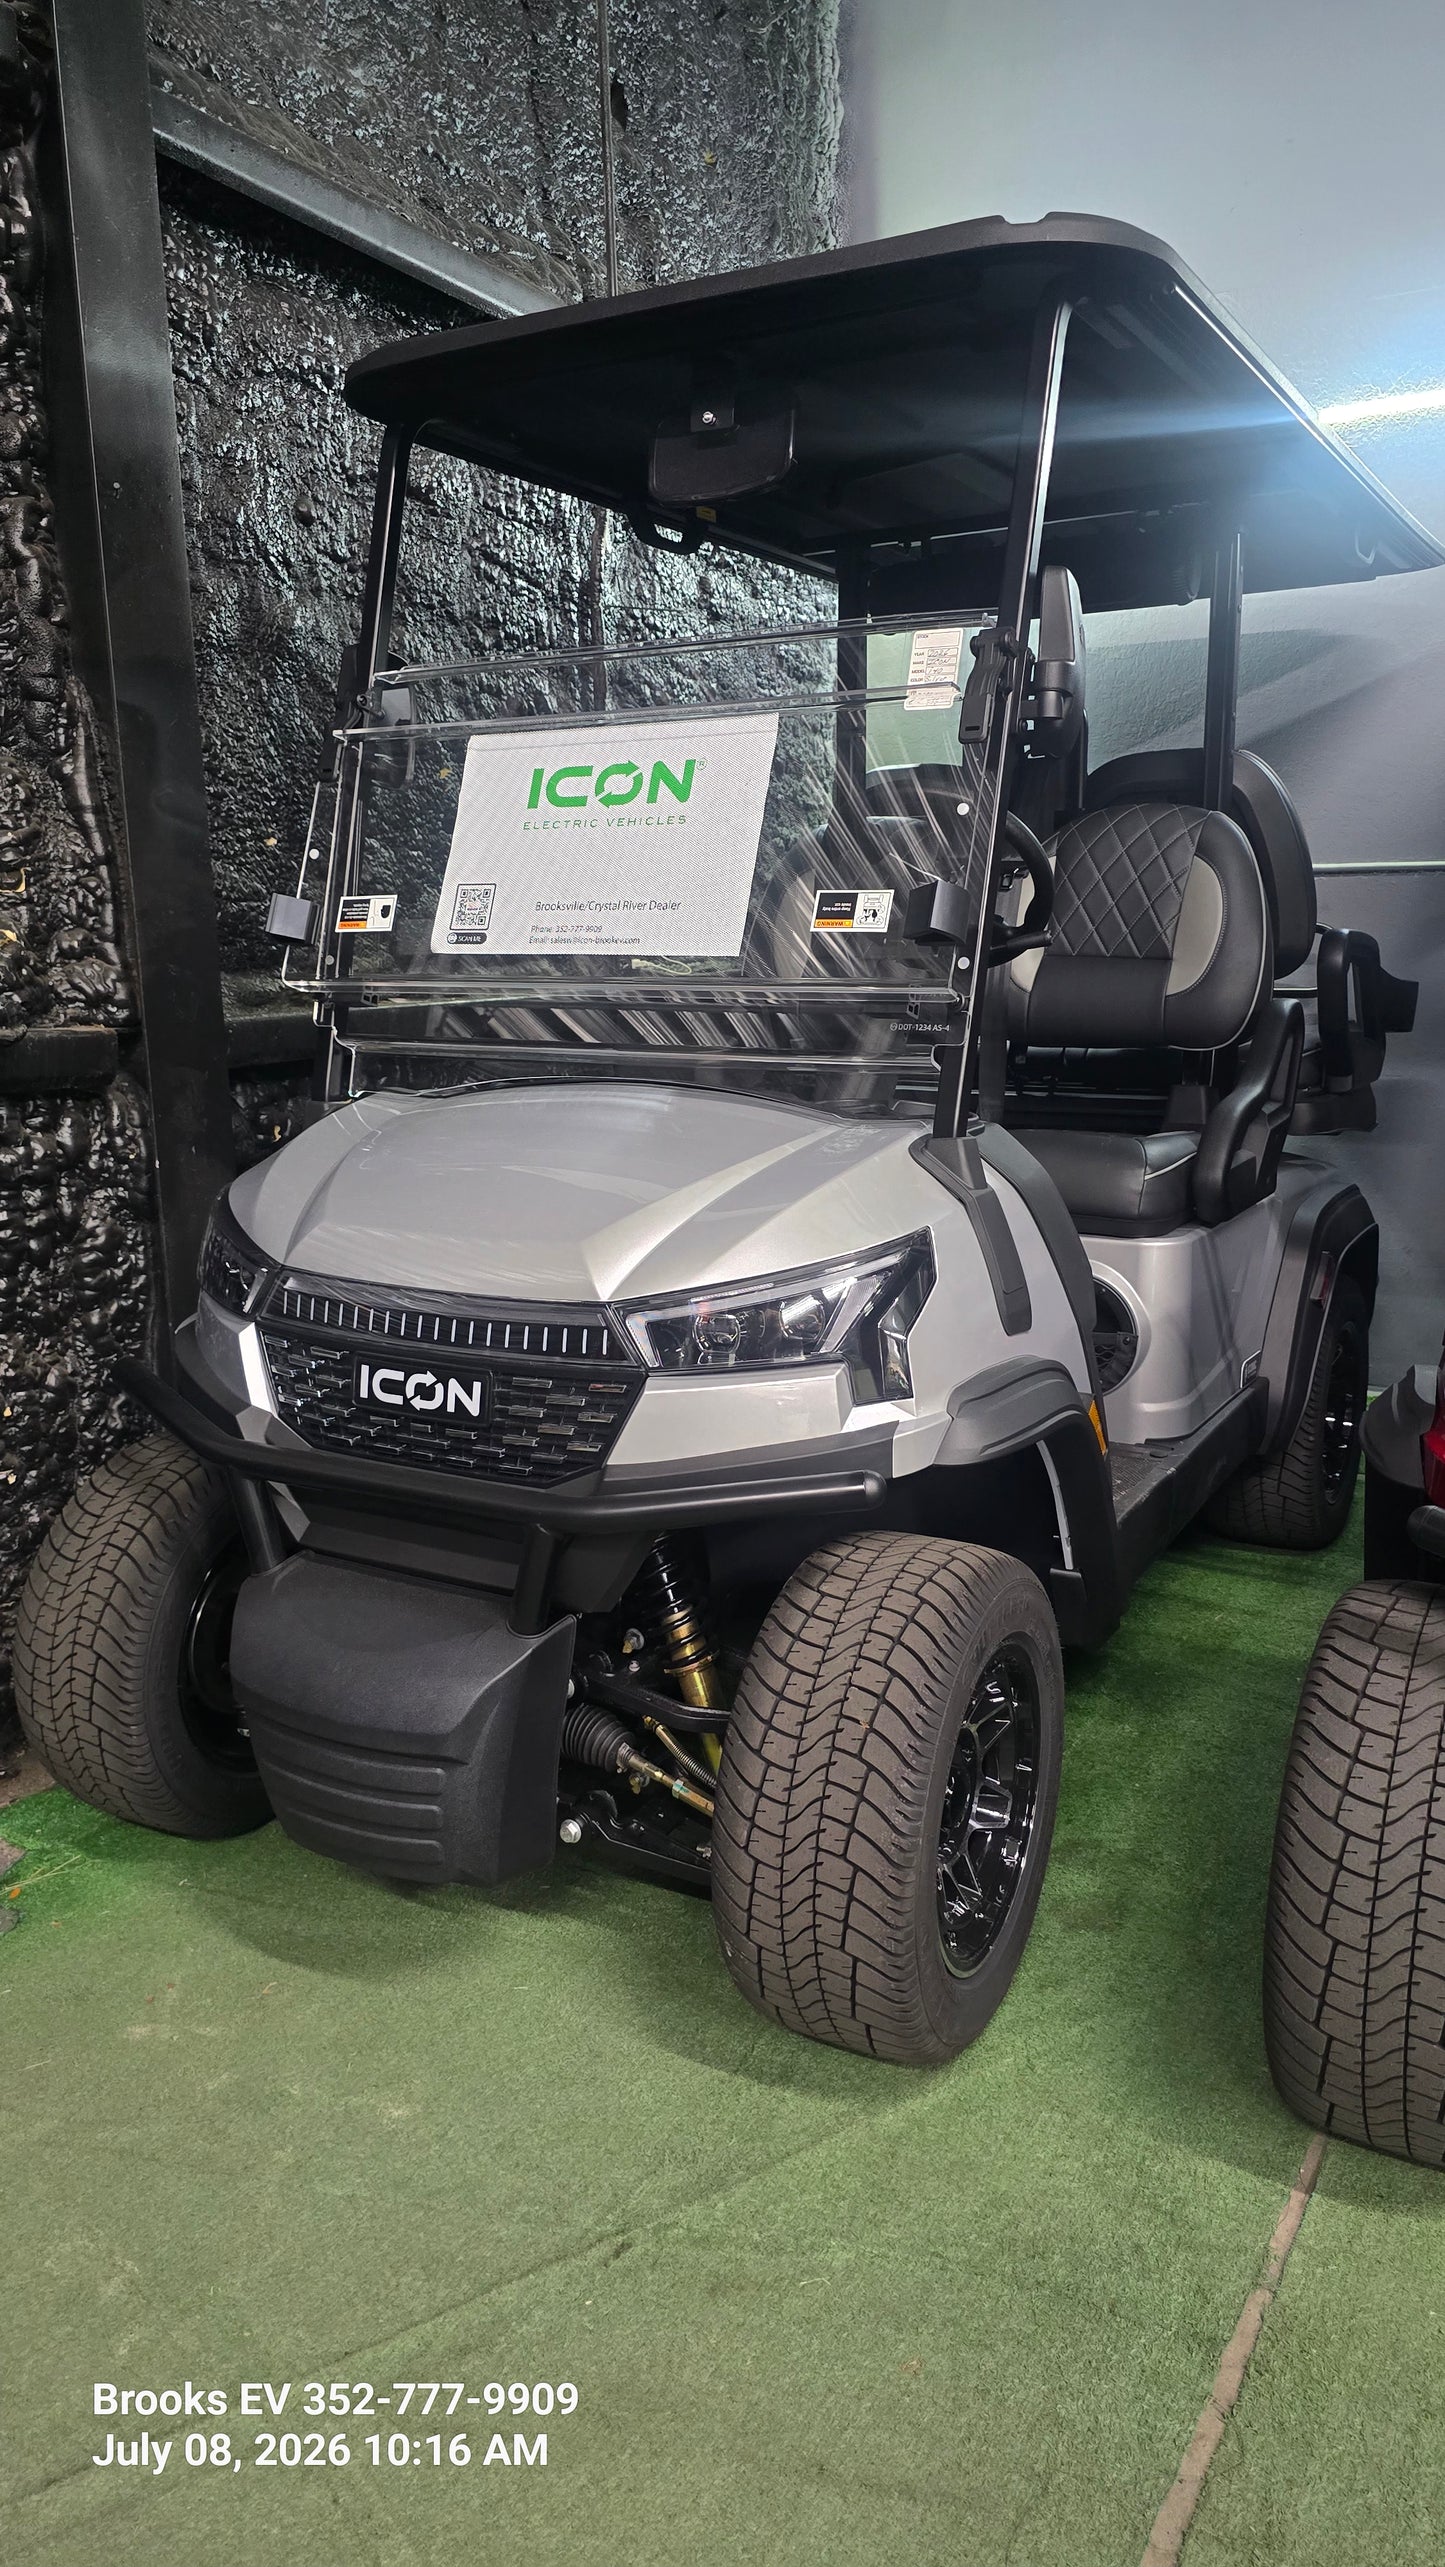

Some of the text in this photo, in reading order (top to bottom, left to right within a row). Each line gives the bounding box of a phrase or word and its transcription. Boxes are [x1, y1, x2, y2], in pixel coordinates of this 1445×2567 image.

[527, 758, 697, 809] ICON
[523, 819, 599, 830] ELECTRIC
[606, 814, 687, 827] VEHICLES
[535, 899, 681, 912] Brooksville/Crystal River Dealer
[555, 925, 603, 933] 352-777-9909
[898, 1023, 950, 1032] DOT-1234 AS-4
[360, 1364, 482, 1417] ICON
